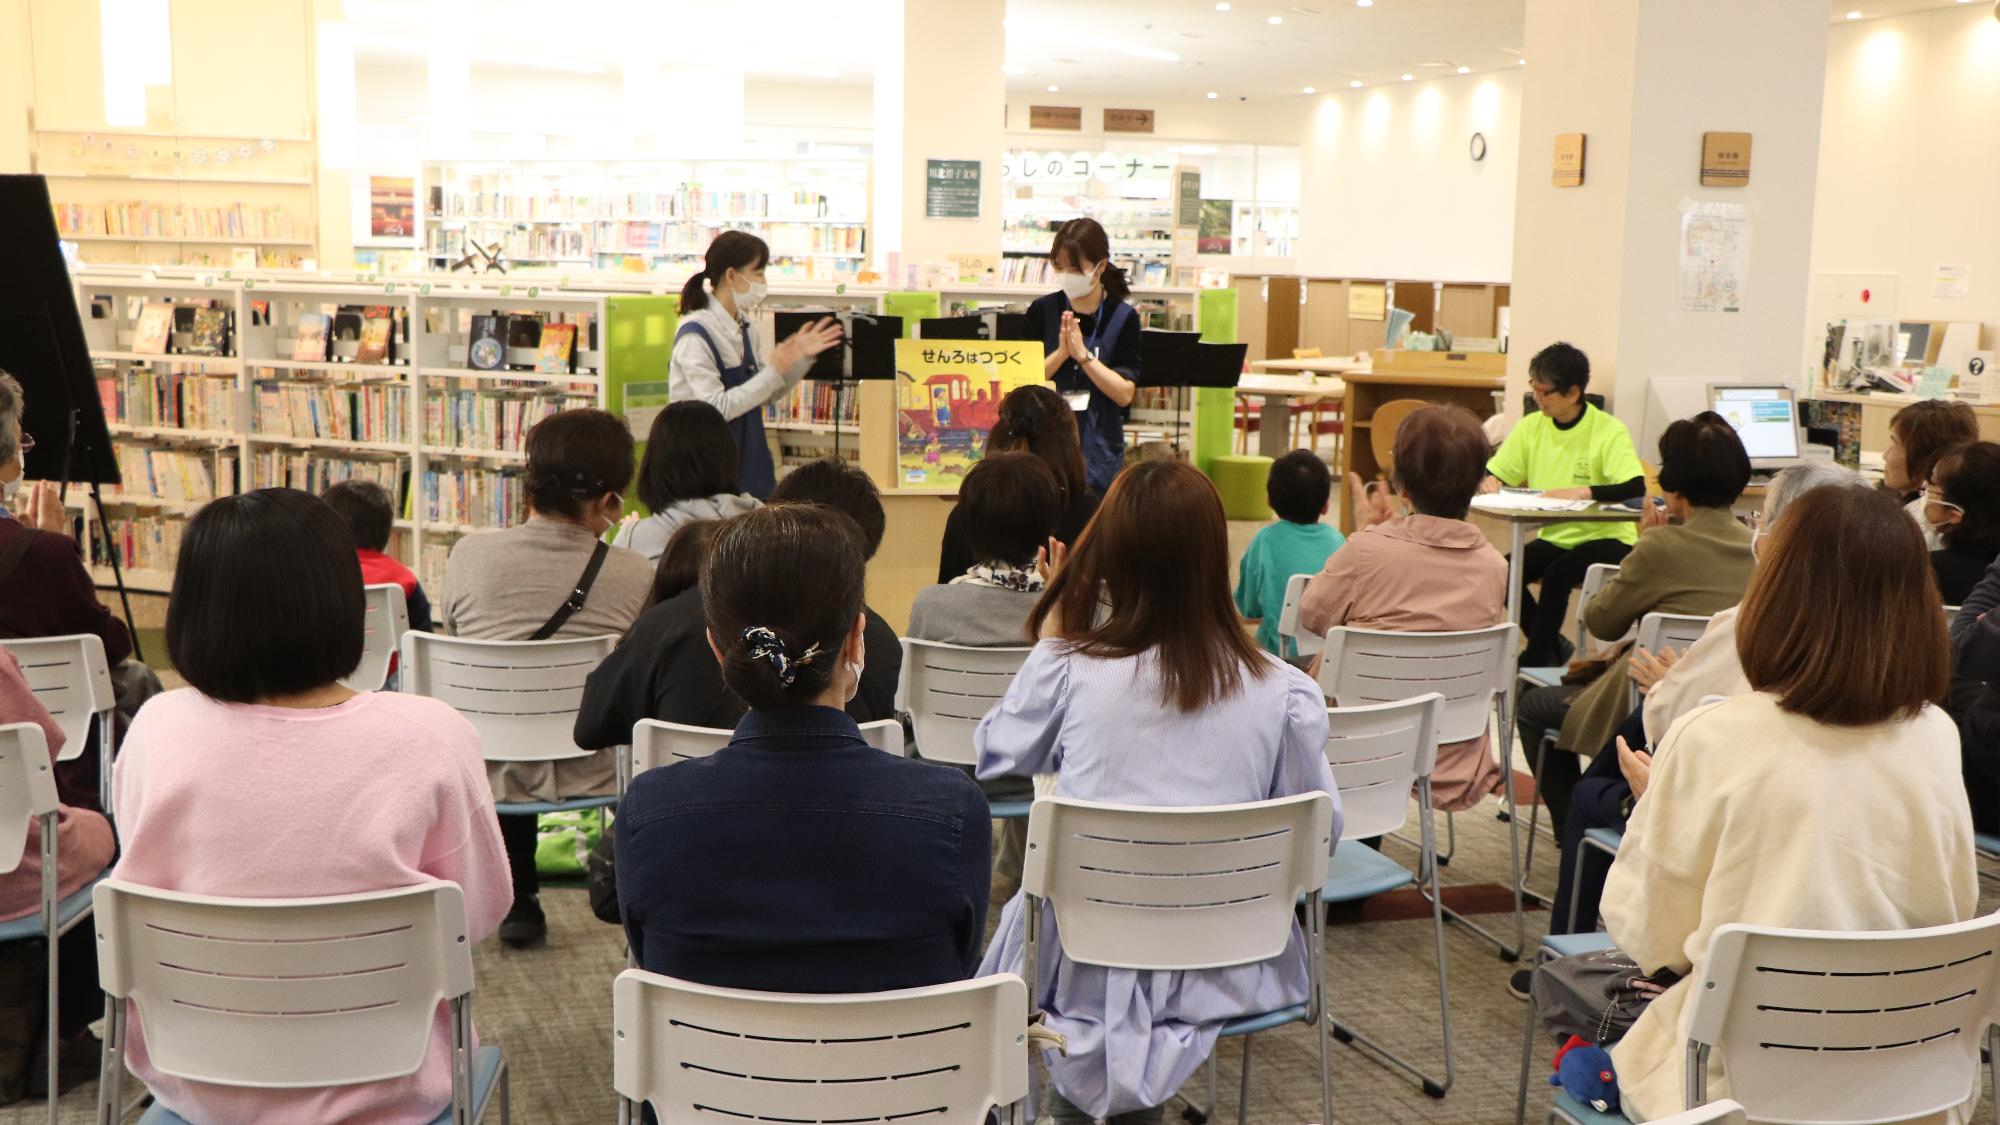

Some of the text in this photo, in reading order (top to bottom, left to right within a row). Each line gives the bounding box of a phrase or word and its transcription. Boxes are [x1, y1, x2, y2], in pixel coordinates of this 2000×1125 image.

[922, 349, 1022, 365] せんろはつづく
